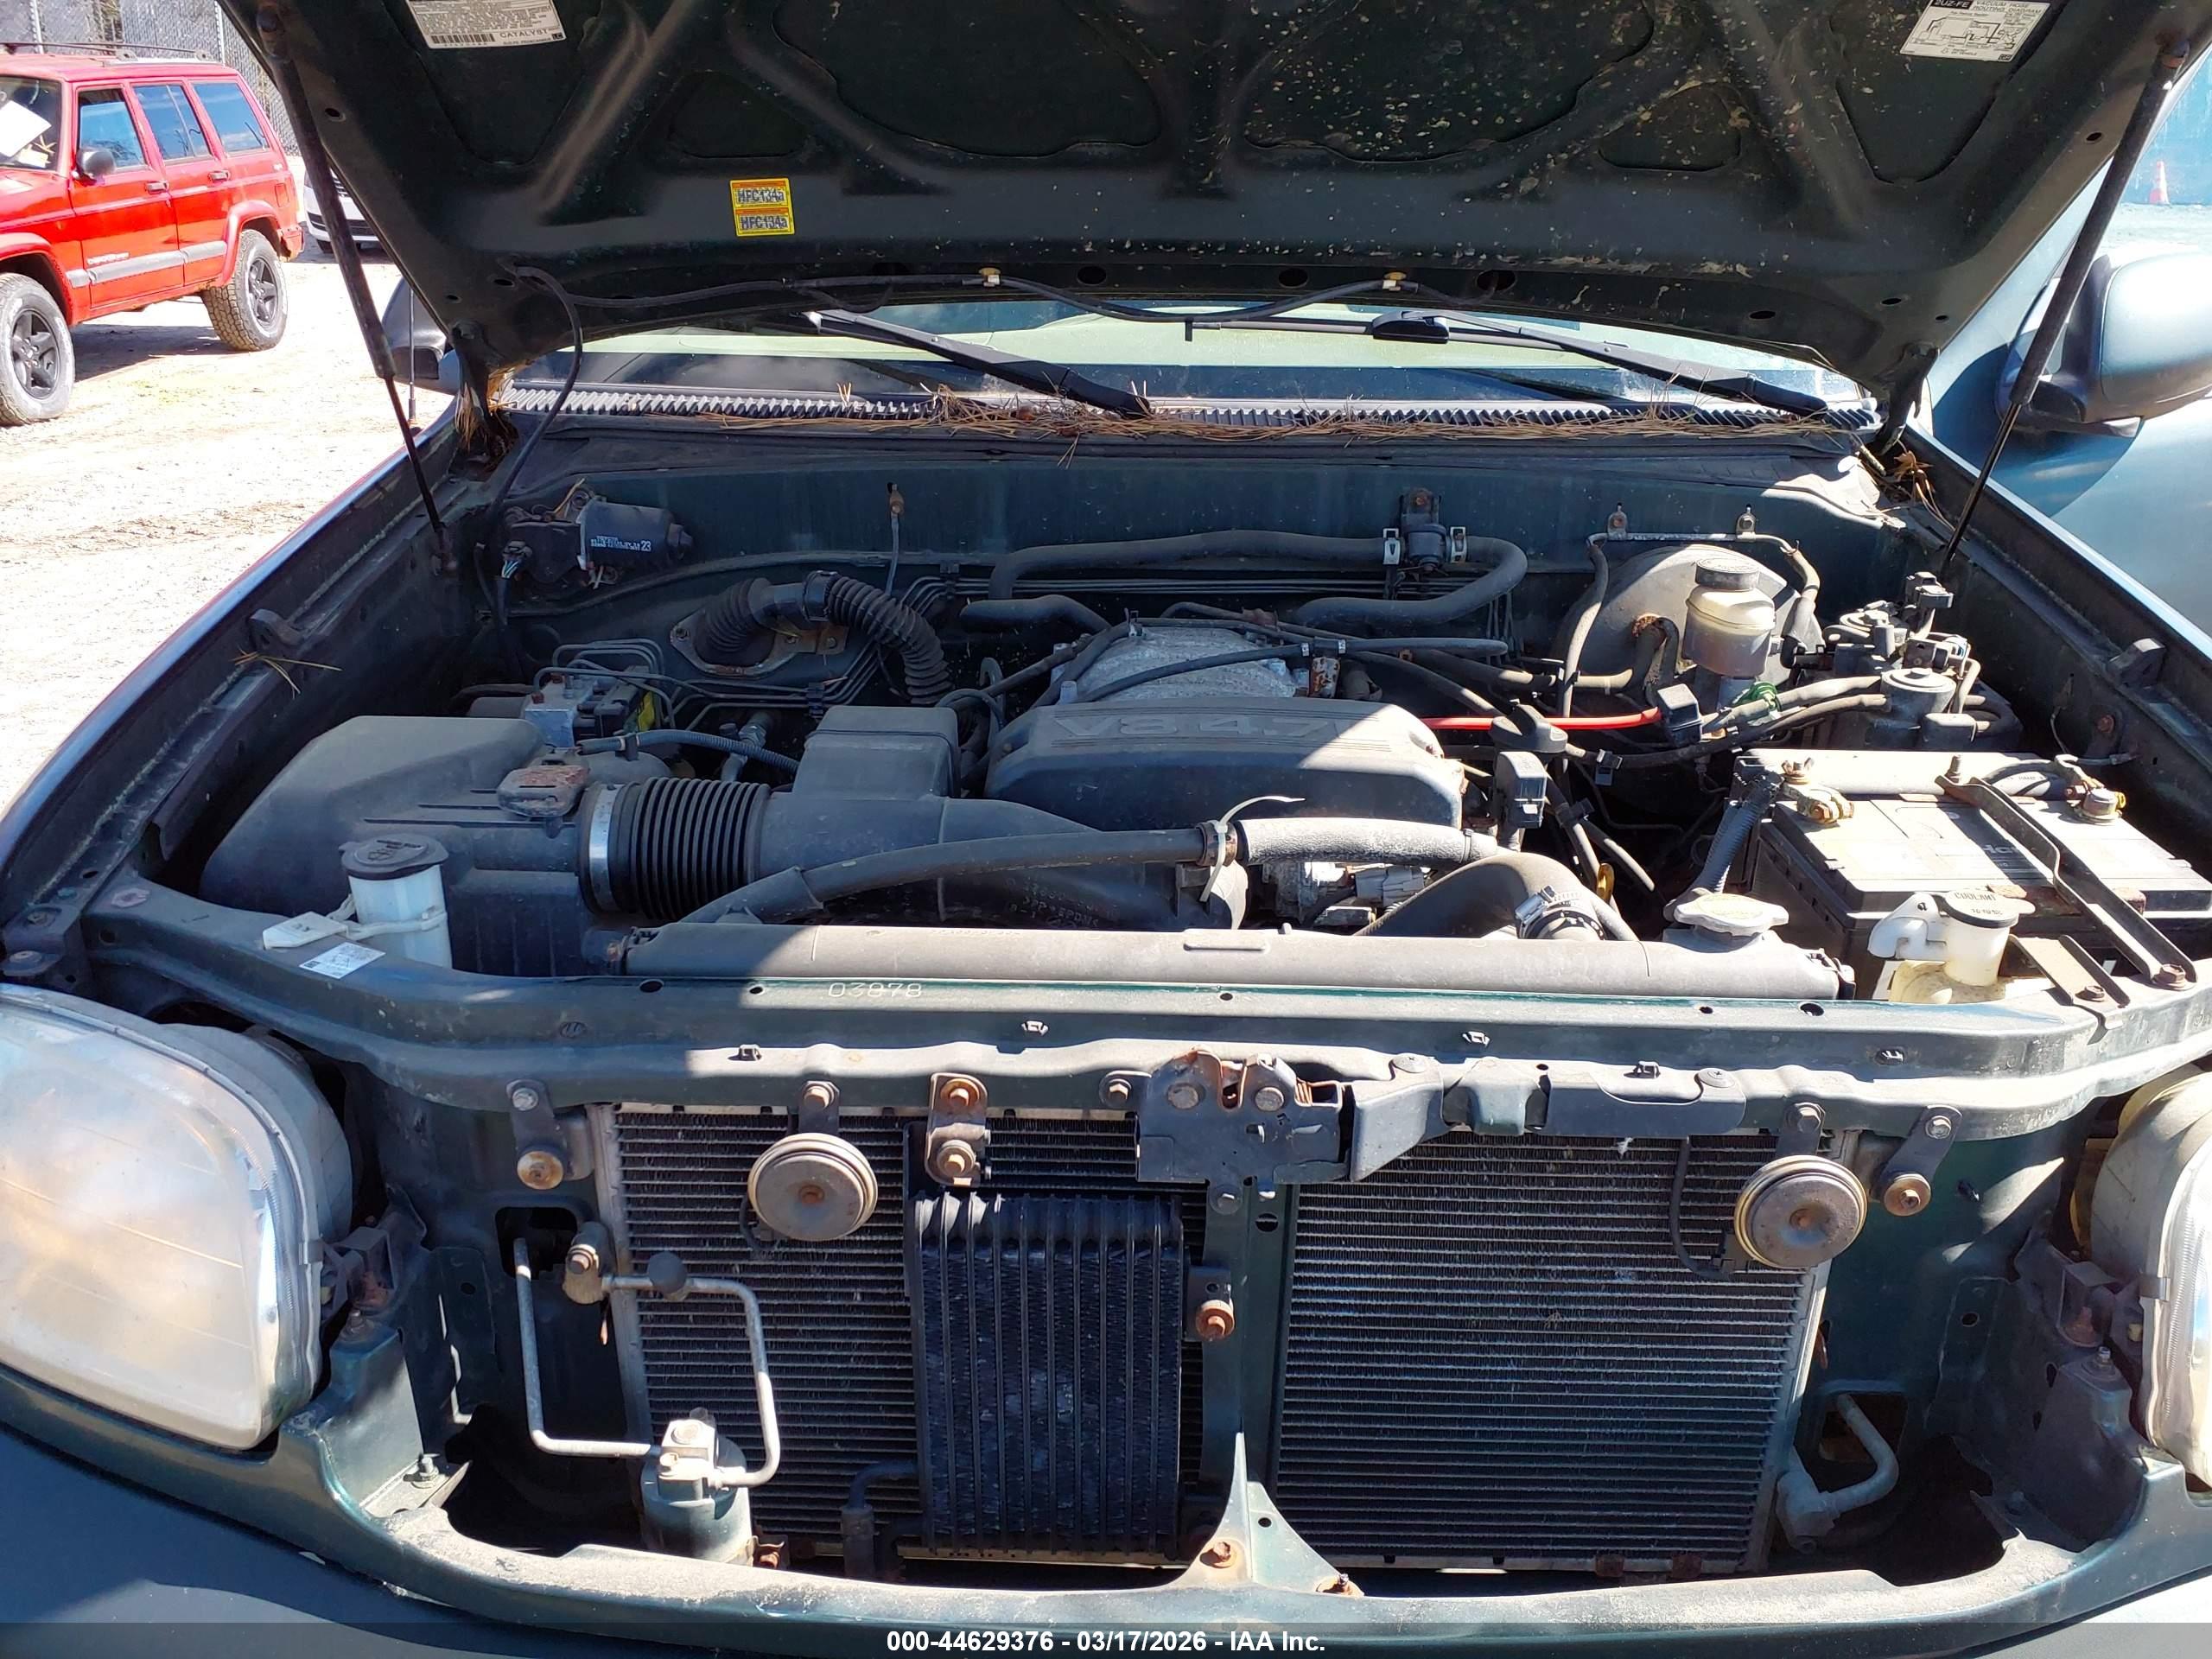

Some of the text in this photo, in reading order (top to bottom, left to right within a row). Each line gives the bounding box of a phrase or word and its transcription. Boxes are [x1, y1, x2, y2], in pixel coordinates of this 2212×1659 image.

[499, 29, 549, 38] CATALYST
[1055, 718, 1177, 737] V8
[829, 982, 922, 997] 03878
